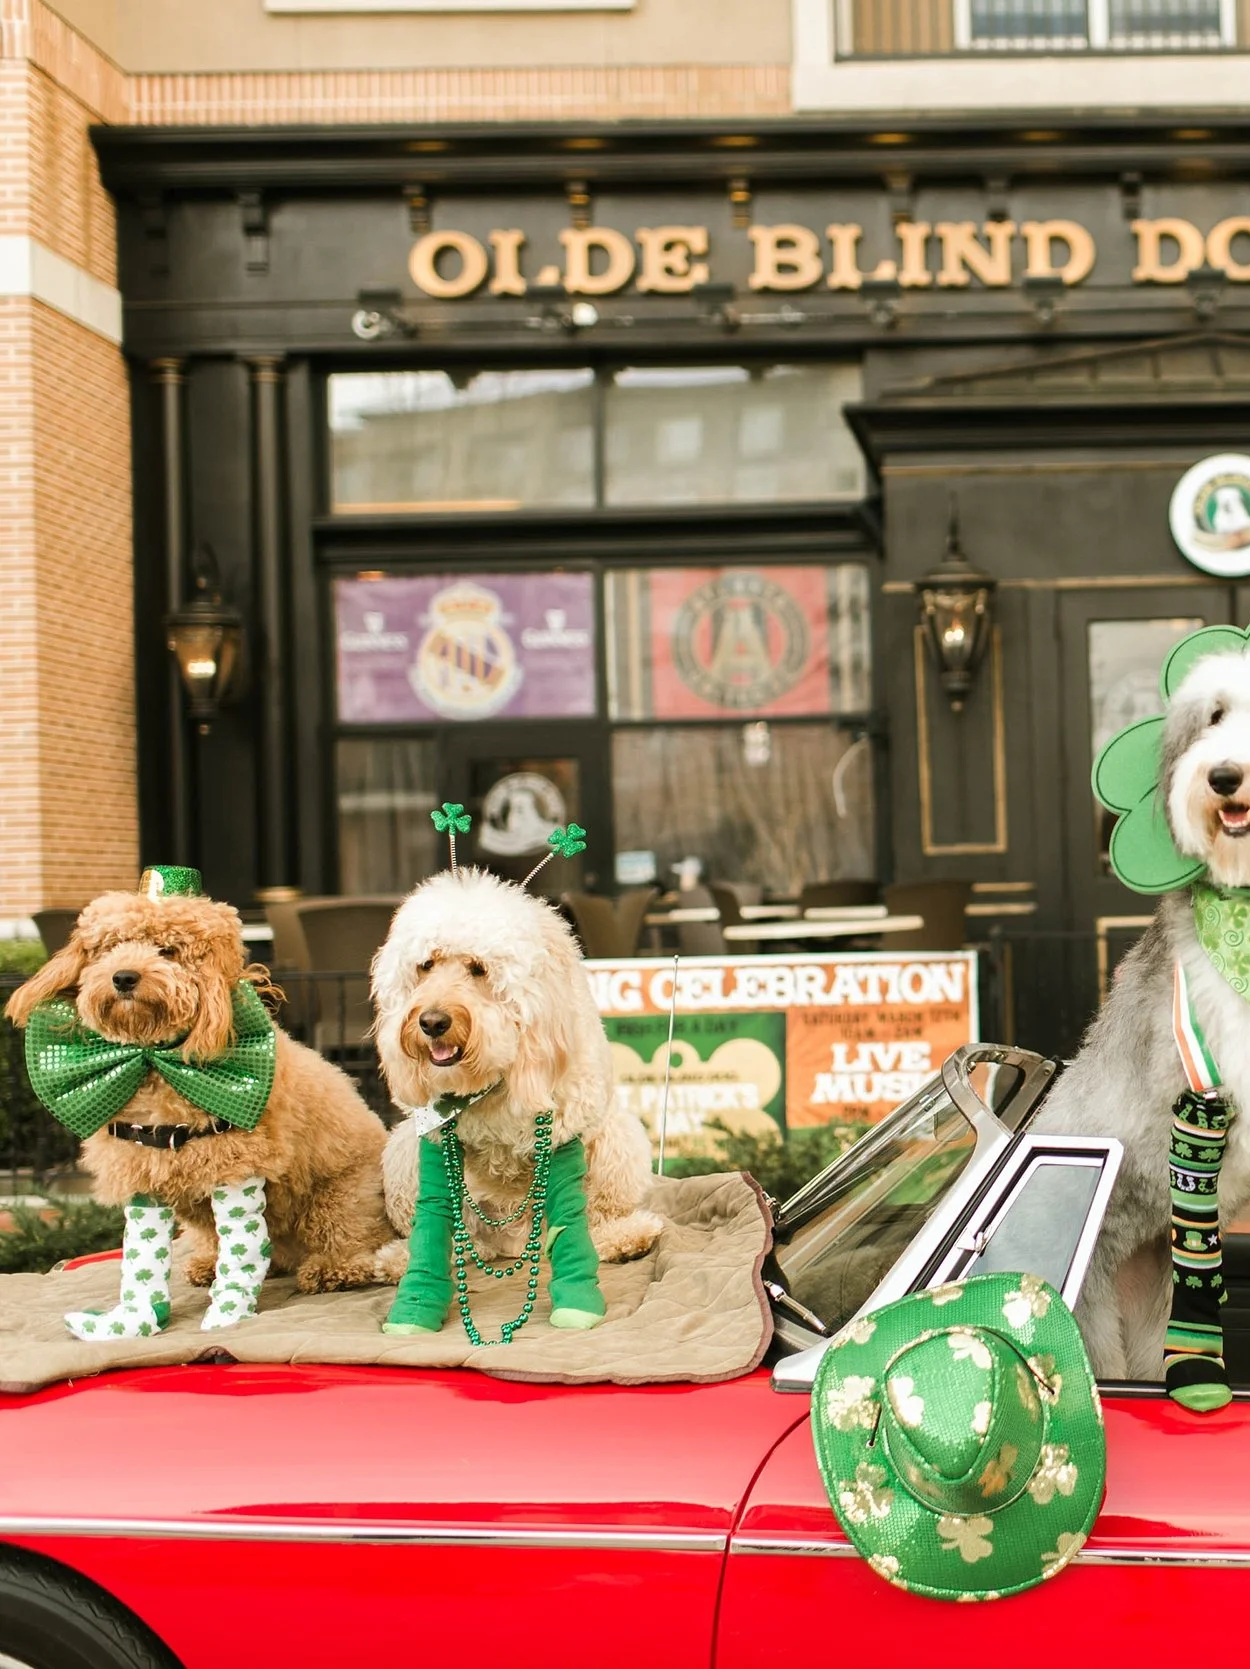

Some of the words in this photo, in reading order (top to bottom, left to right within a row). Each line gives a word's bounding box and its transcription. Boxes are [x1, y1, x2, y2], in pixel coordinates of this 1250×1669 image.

[408, 228, 709, 298] OLDE
[748, 219, 1096, 291] BLIND
[588, 969, 643, 1011] IG
[649, 962, 965, 1010] CELEBRATION
[831, 1041, 931, 1073] LIVE
